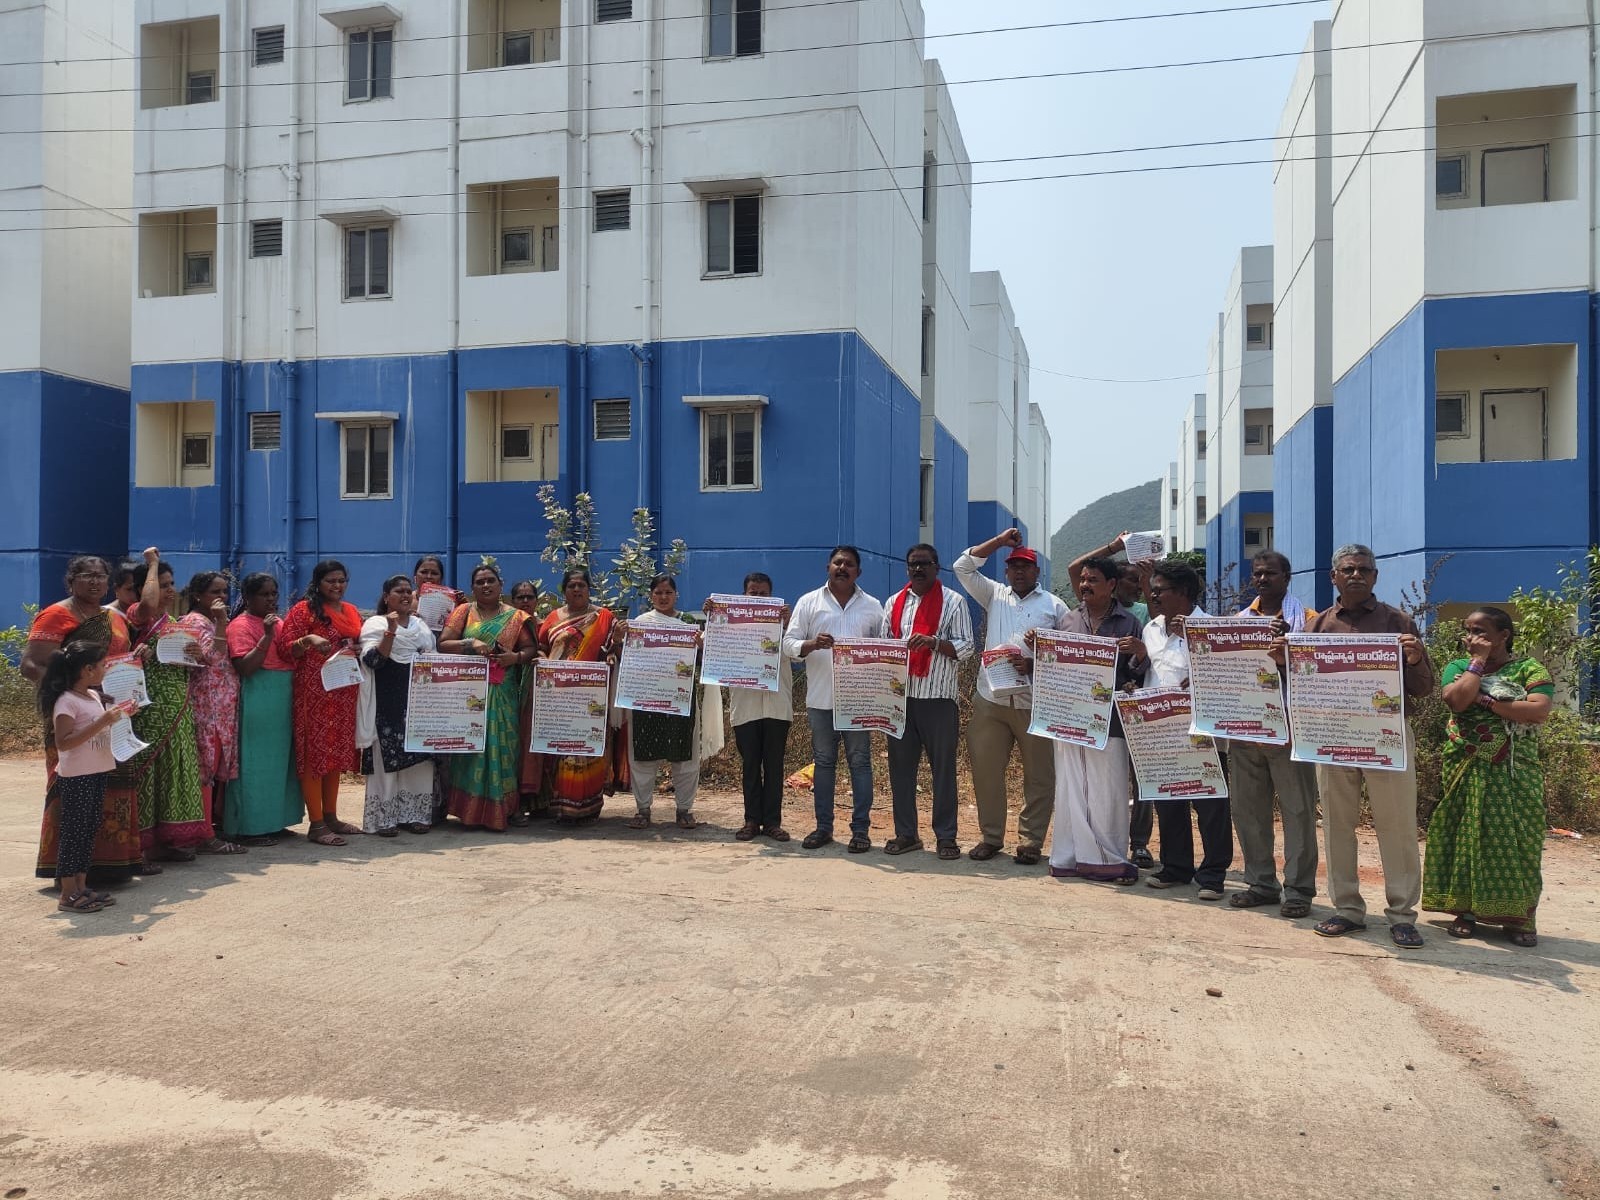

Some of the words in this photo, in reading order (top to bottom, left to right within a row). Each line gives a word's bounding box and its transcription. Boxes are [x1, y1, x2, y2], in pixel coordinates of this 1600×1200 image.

[1207, 632, 1240, 645] రాష్ట్రవ్యాప్త
[1241, 631, 1273, 642] ఆందోళన
[1314, 650, 1355, 664] రాష్ట్రవ్యాప్త
[1357, 650, 1398, 662] ఆందోళన
